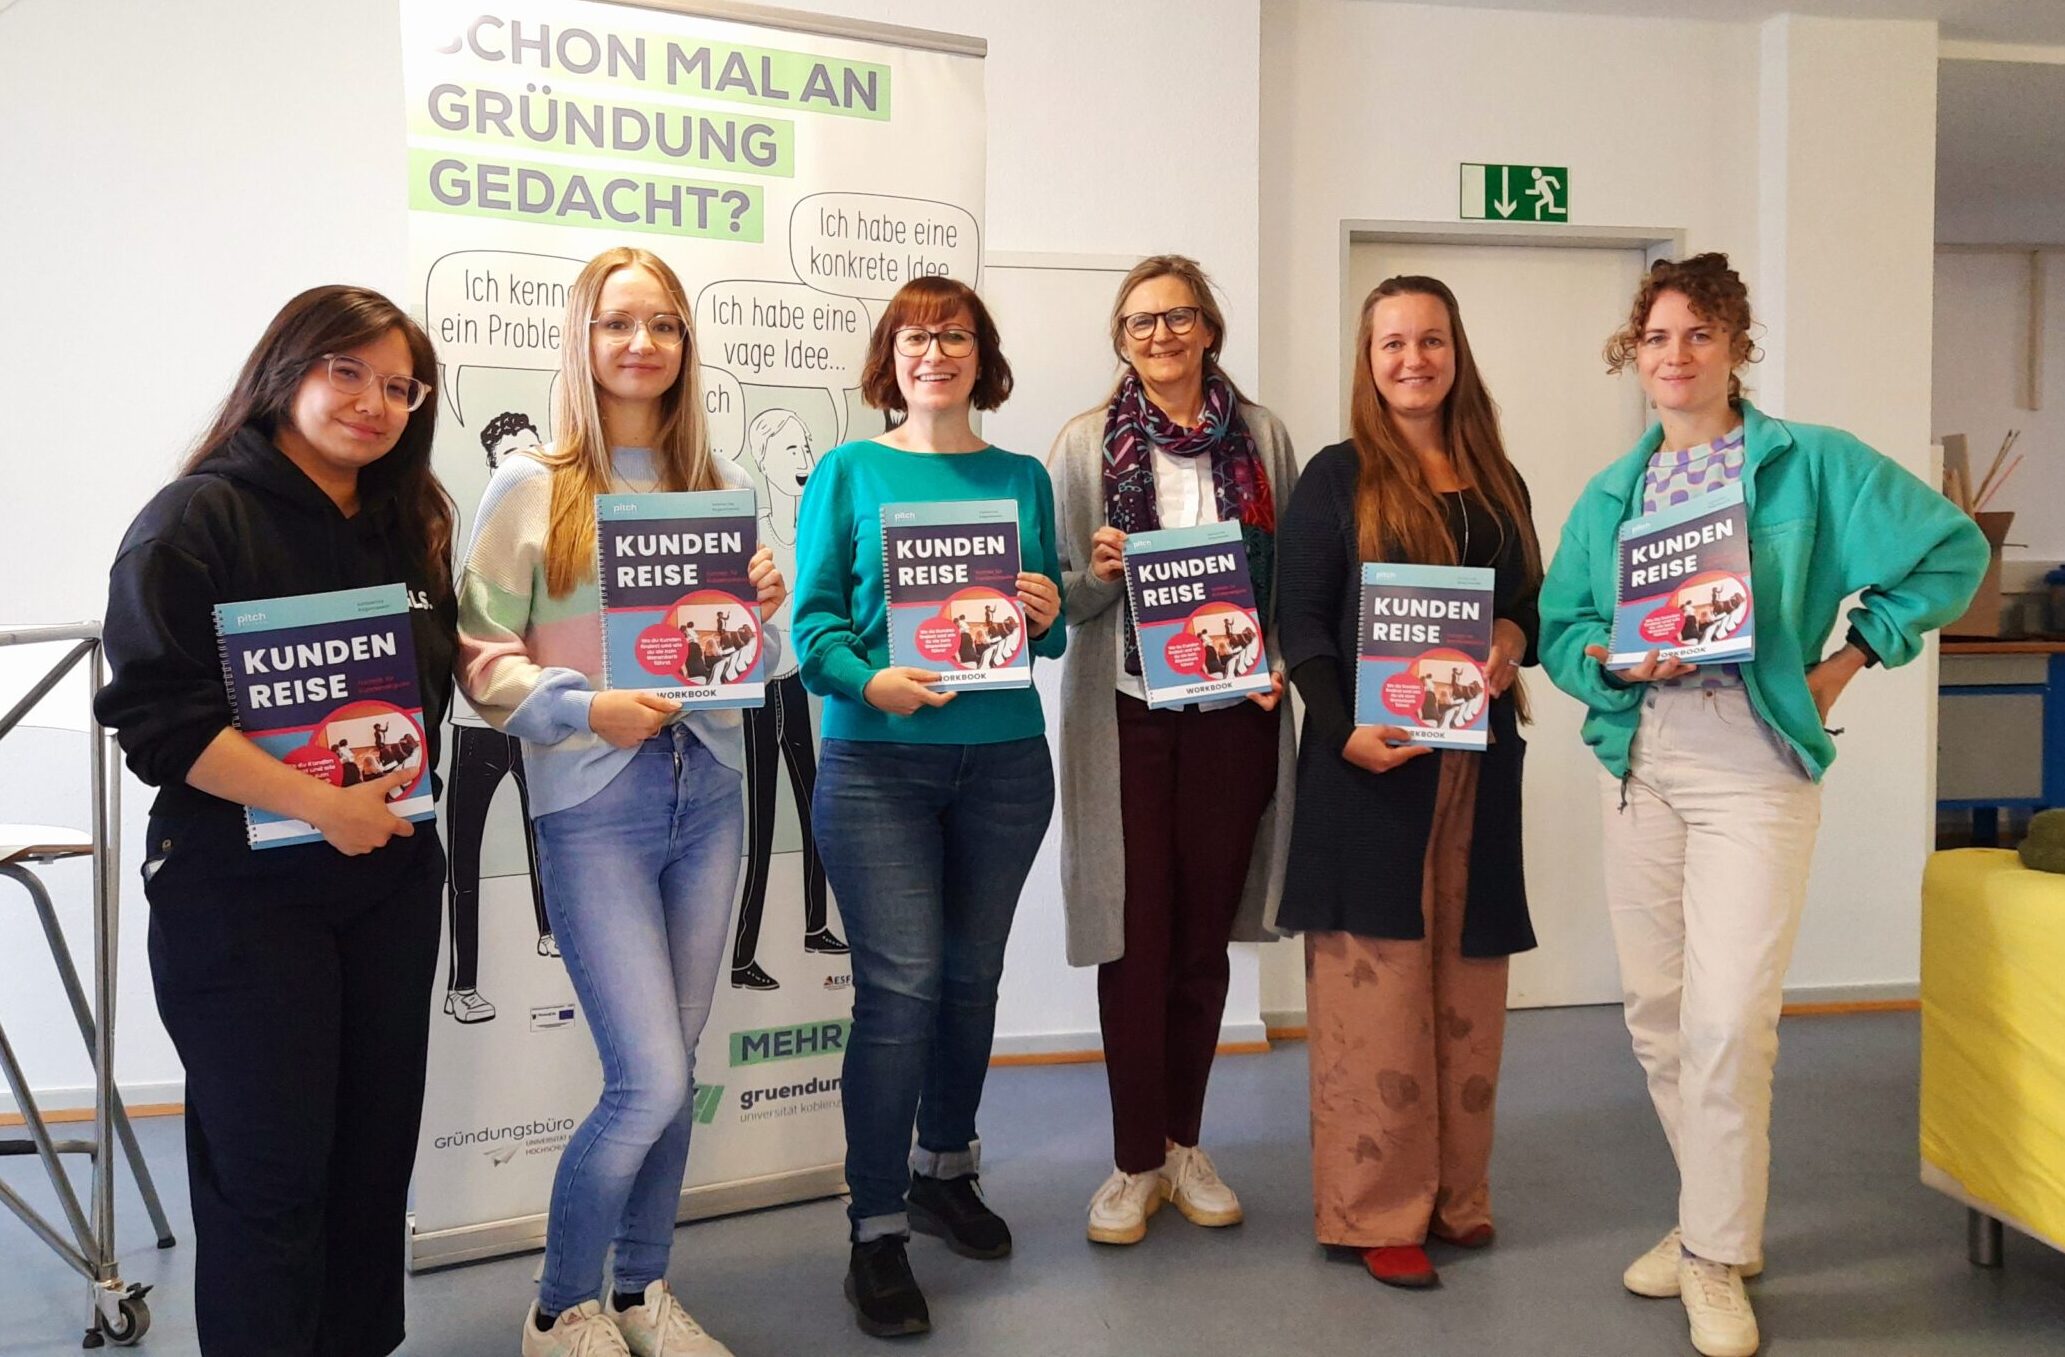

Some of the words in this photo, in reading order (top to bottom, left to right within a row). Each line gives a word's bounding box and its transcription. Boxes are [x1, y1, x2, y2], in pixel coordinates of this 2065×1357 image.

[667, 42, 790, 101] MAL
[799, 63, 877, 112] AN
[427, 82, 777, 168] GRÜNDUNG
[428, 158, 751, 233] GEDACHT?
[820, 207, 848, 239] Ich
[857, 210, 907, 245] habe
[914, 218, 958, 249] eine
[810, 245, 899, 283] konkrete
[465, 269, 499, 303] Ich
[441, 313, 478, 344] ein
[712, 294, 743, 326] Ich
[752, 297, 805, 330] habe
[813, 303, 857, 334] eine
[724, 342, 776, 374] vage
[784, 338, 846, 371] Idee...
[615, 532, 742, 557] KUNDEN
[896, 535, 1006, 559] KUNDEN
[1631, 518, 1734, 566] KUNDEN
[617, 563, 699, 588] REISE
[898, 564, 969, 586] REISE
[1138, 553, 1236, 583] KUNDEN
[1631, 554, 1698, 588] REISE
[1142, 582, 1206, 608] REISE
[1374, 597, 1480, 621] KUNDEN
[236, 612, 267, 627] pitch
[1372, 622, 1441, 644] REISE
[243, 631, 397, 675] KUNDEN
[248, 674, 349, 710] REISE
[1186, 682, 1233, 695] WORKBOOK
[741, 1024, 843, 1062] MEHR
